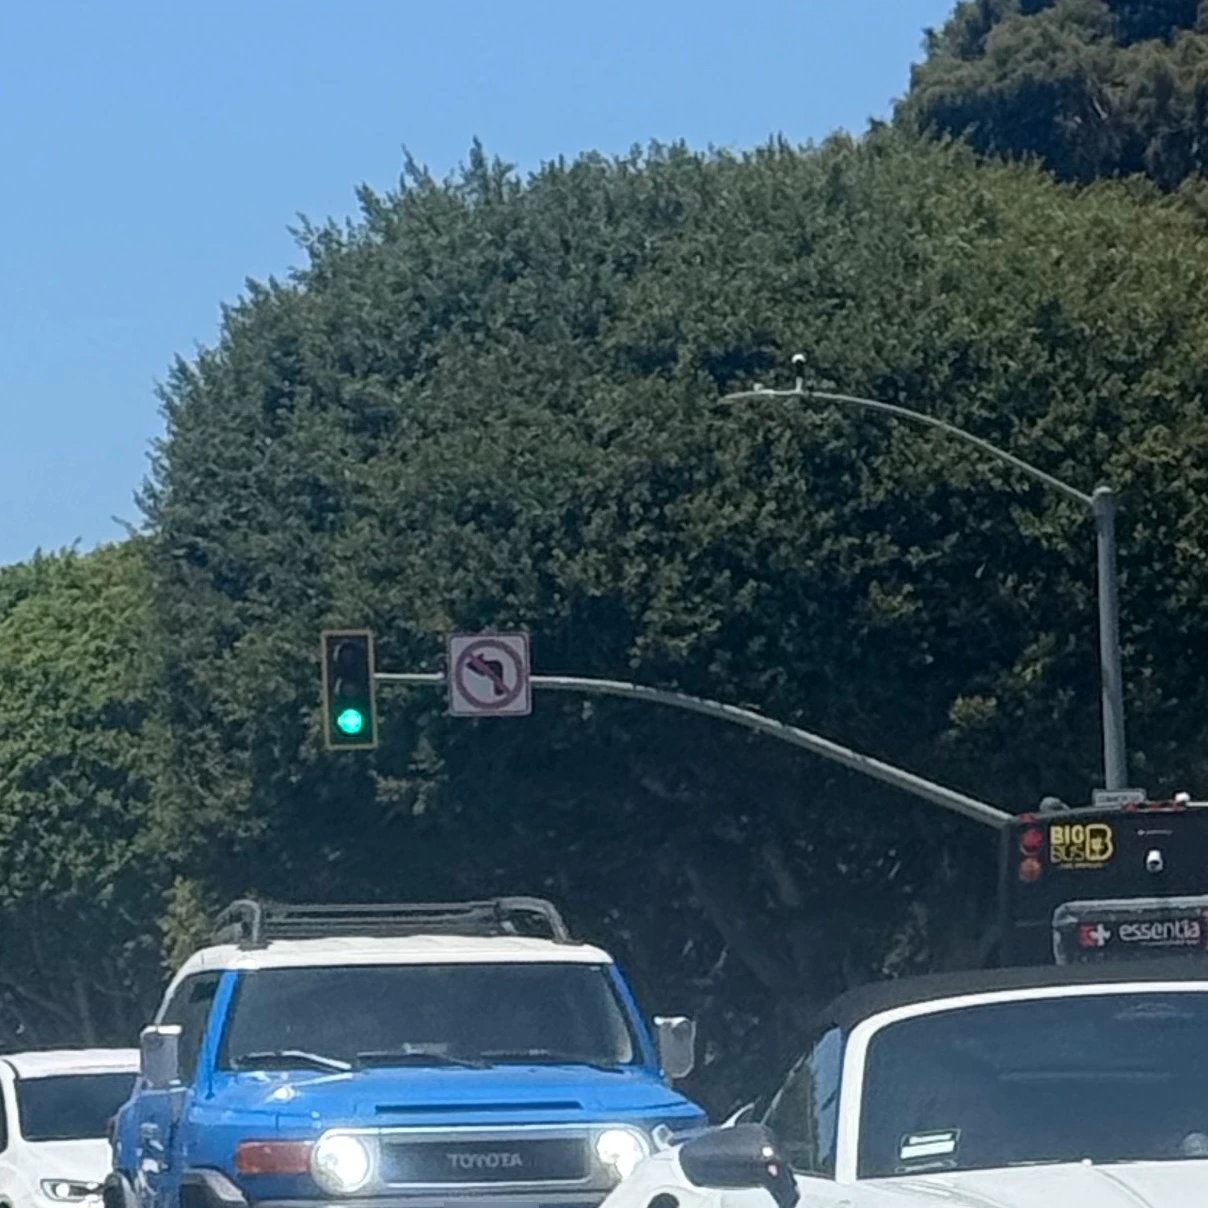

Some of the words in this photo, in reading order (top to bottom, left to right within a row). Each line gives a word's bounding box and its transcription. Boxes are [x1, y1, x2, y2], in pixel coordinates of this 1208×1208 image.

[1050, 825, 1084, 844] BIG
[1050, 844, 1084, 863] BUS
[1119, 919, 1201, 942] essentia
[446, 1153, 523, 1169] TOYOTA
